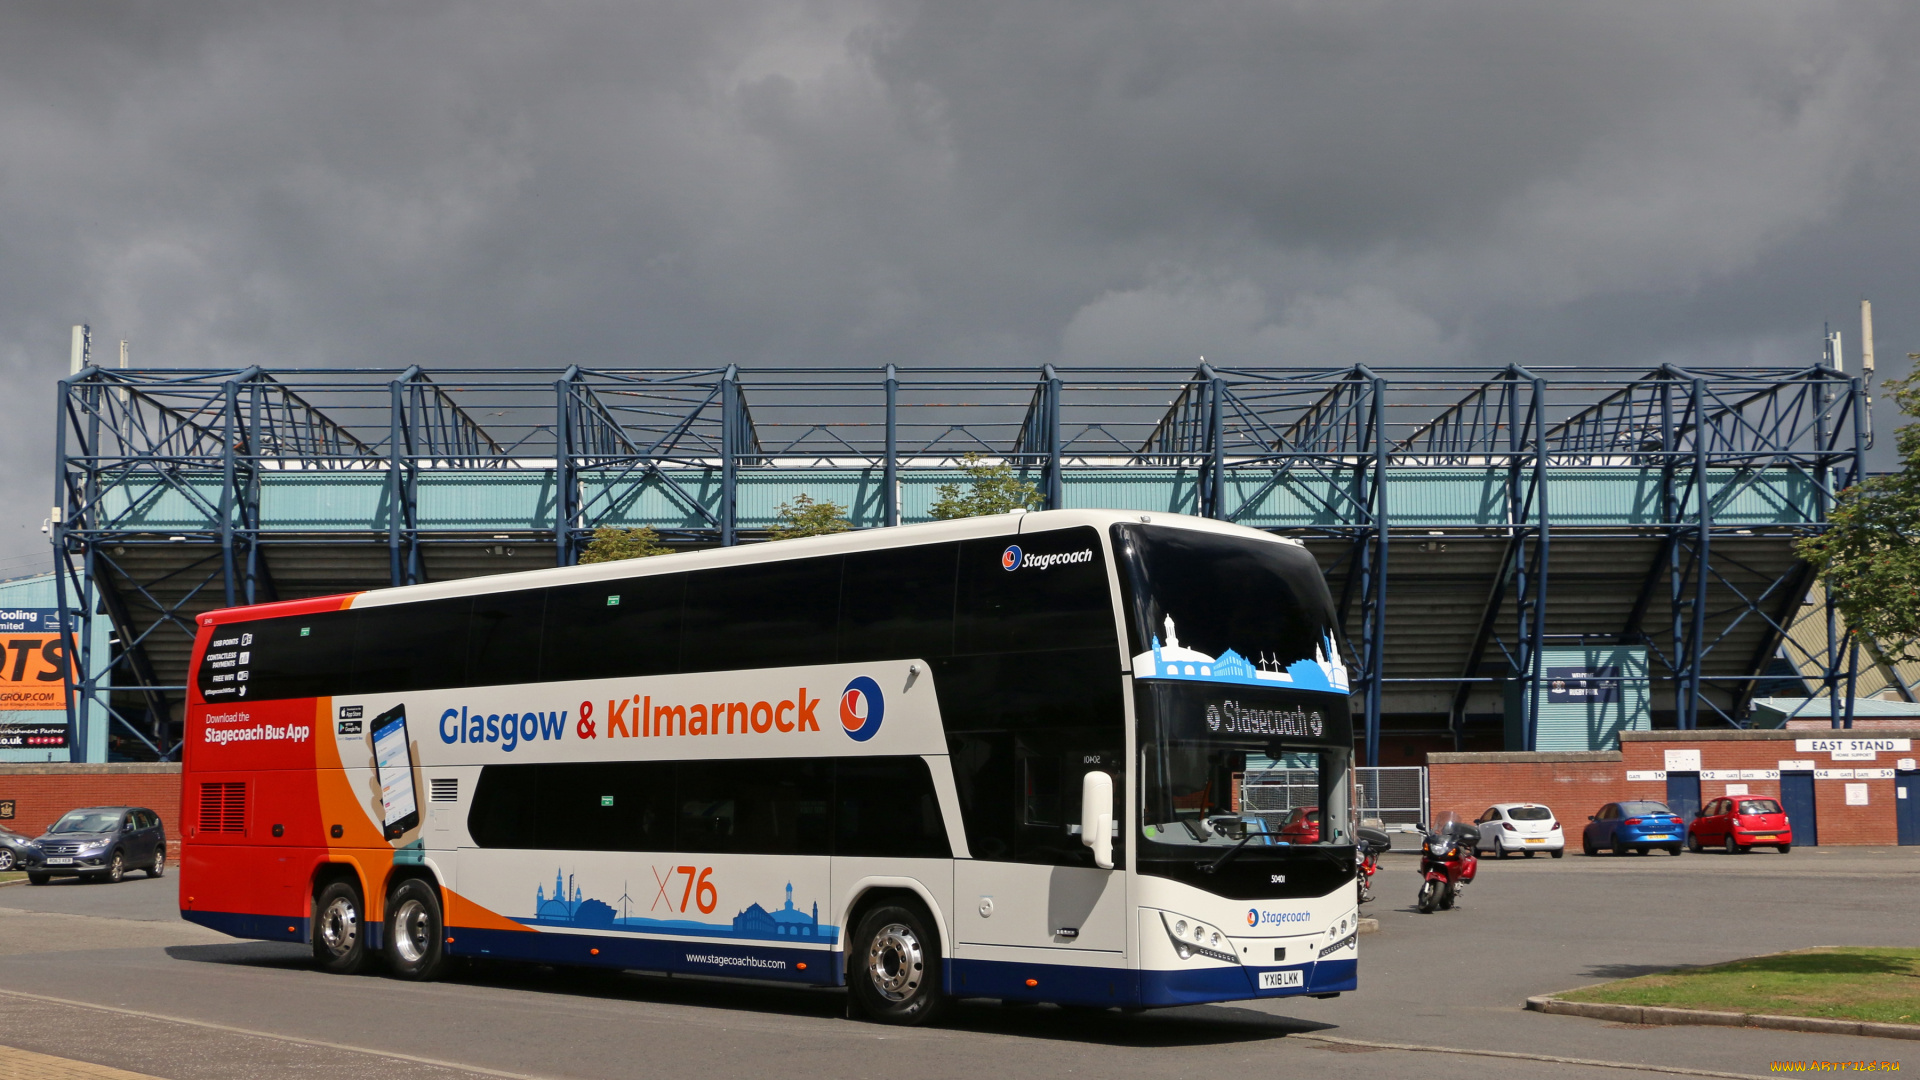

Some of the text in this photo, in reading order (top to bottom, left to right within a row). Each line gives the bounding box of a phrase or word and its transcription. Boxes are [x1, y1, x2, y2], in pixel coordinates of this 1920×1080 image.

[1022, 548, 1092, 570] Stagecoach
[0, 639, 64, 682] TS
[206, 711, 250, 724] Download the
[439, 687, 821, 752] Glasgow & Kilmarnock
[1223, 700, 1308, 735] Stagecoach
[0, 736, 22, 745] o.uk
[205, 723, 310, 745] Stagecoach Bus App
[1812, 741, 1894, 750] EAST STAND
[1271, 875, 1286, 884] 50401
[651, 865, 717, 914] X76
[1261, 911, 1311, 926] Stagecoach
[686, 954, 786, 969] www.stagecoachbus.com
[1264, 972, 1299, 986] YX18 LKK
